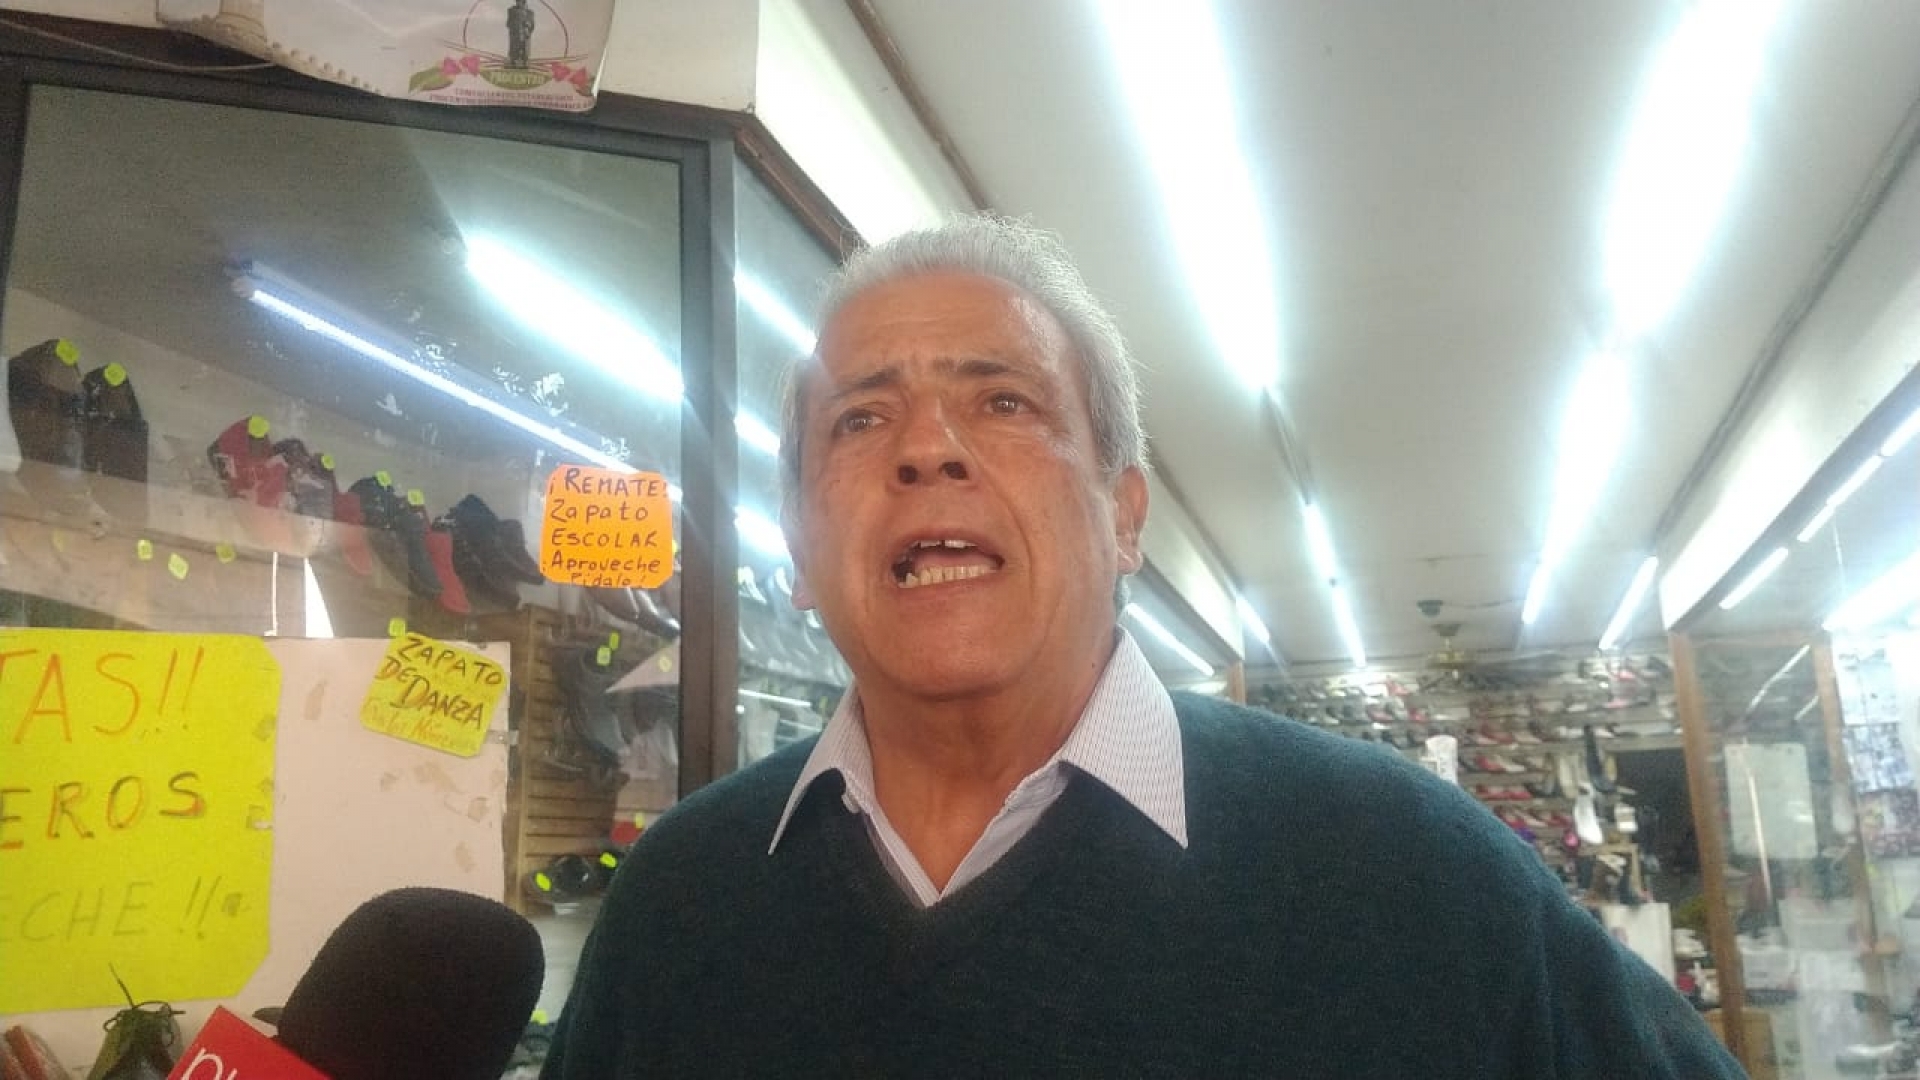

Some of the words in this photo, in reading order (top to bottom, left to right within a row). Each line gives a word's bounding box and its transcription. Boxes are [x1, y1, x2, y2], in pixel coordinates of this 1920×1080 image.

[374, 655, 414, 683] DE
[396, 637, 503, 686] ZAPATO
[389, 674, 485, 730] DANZA
